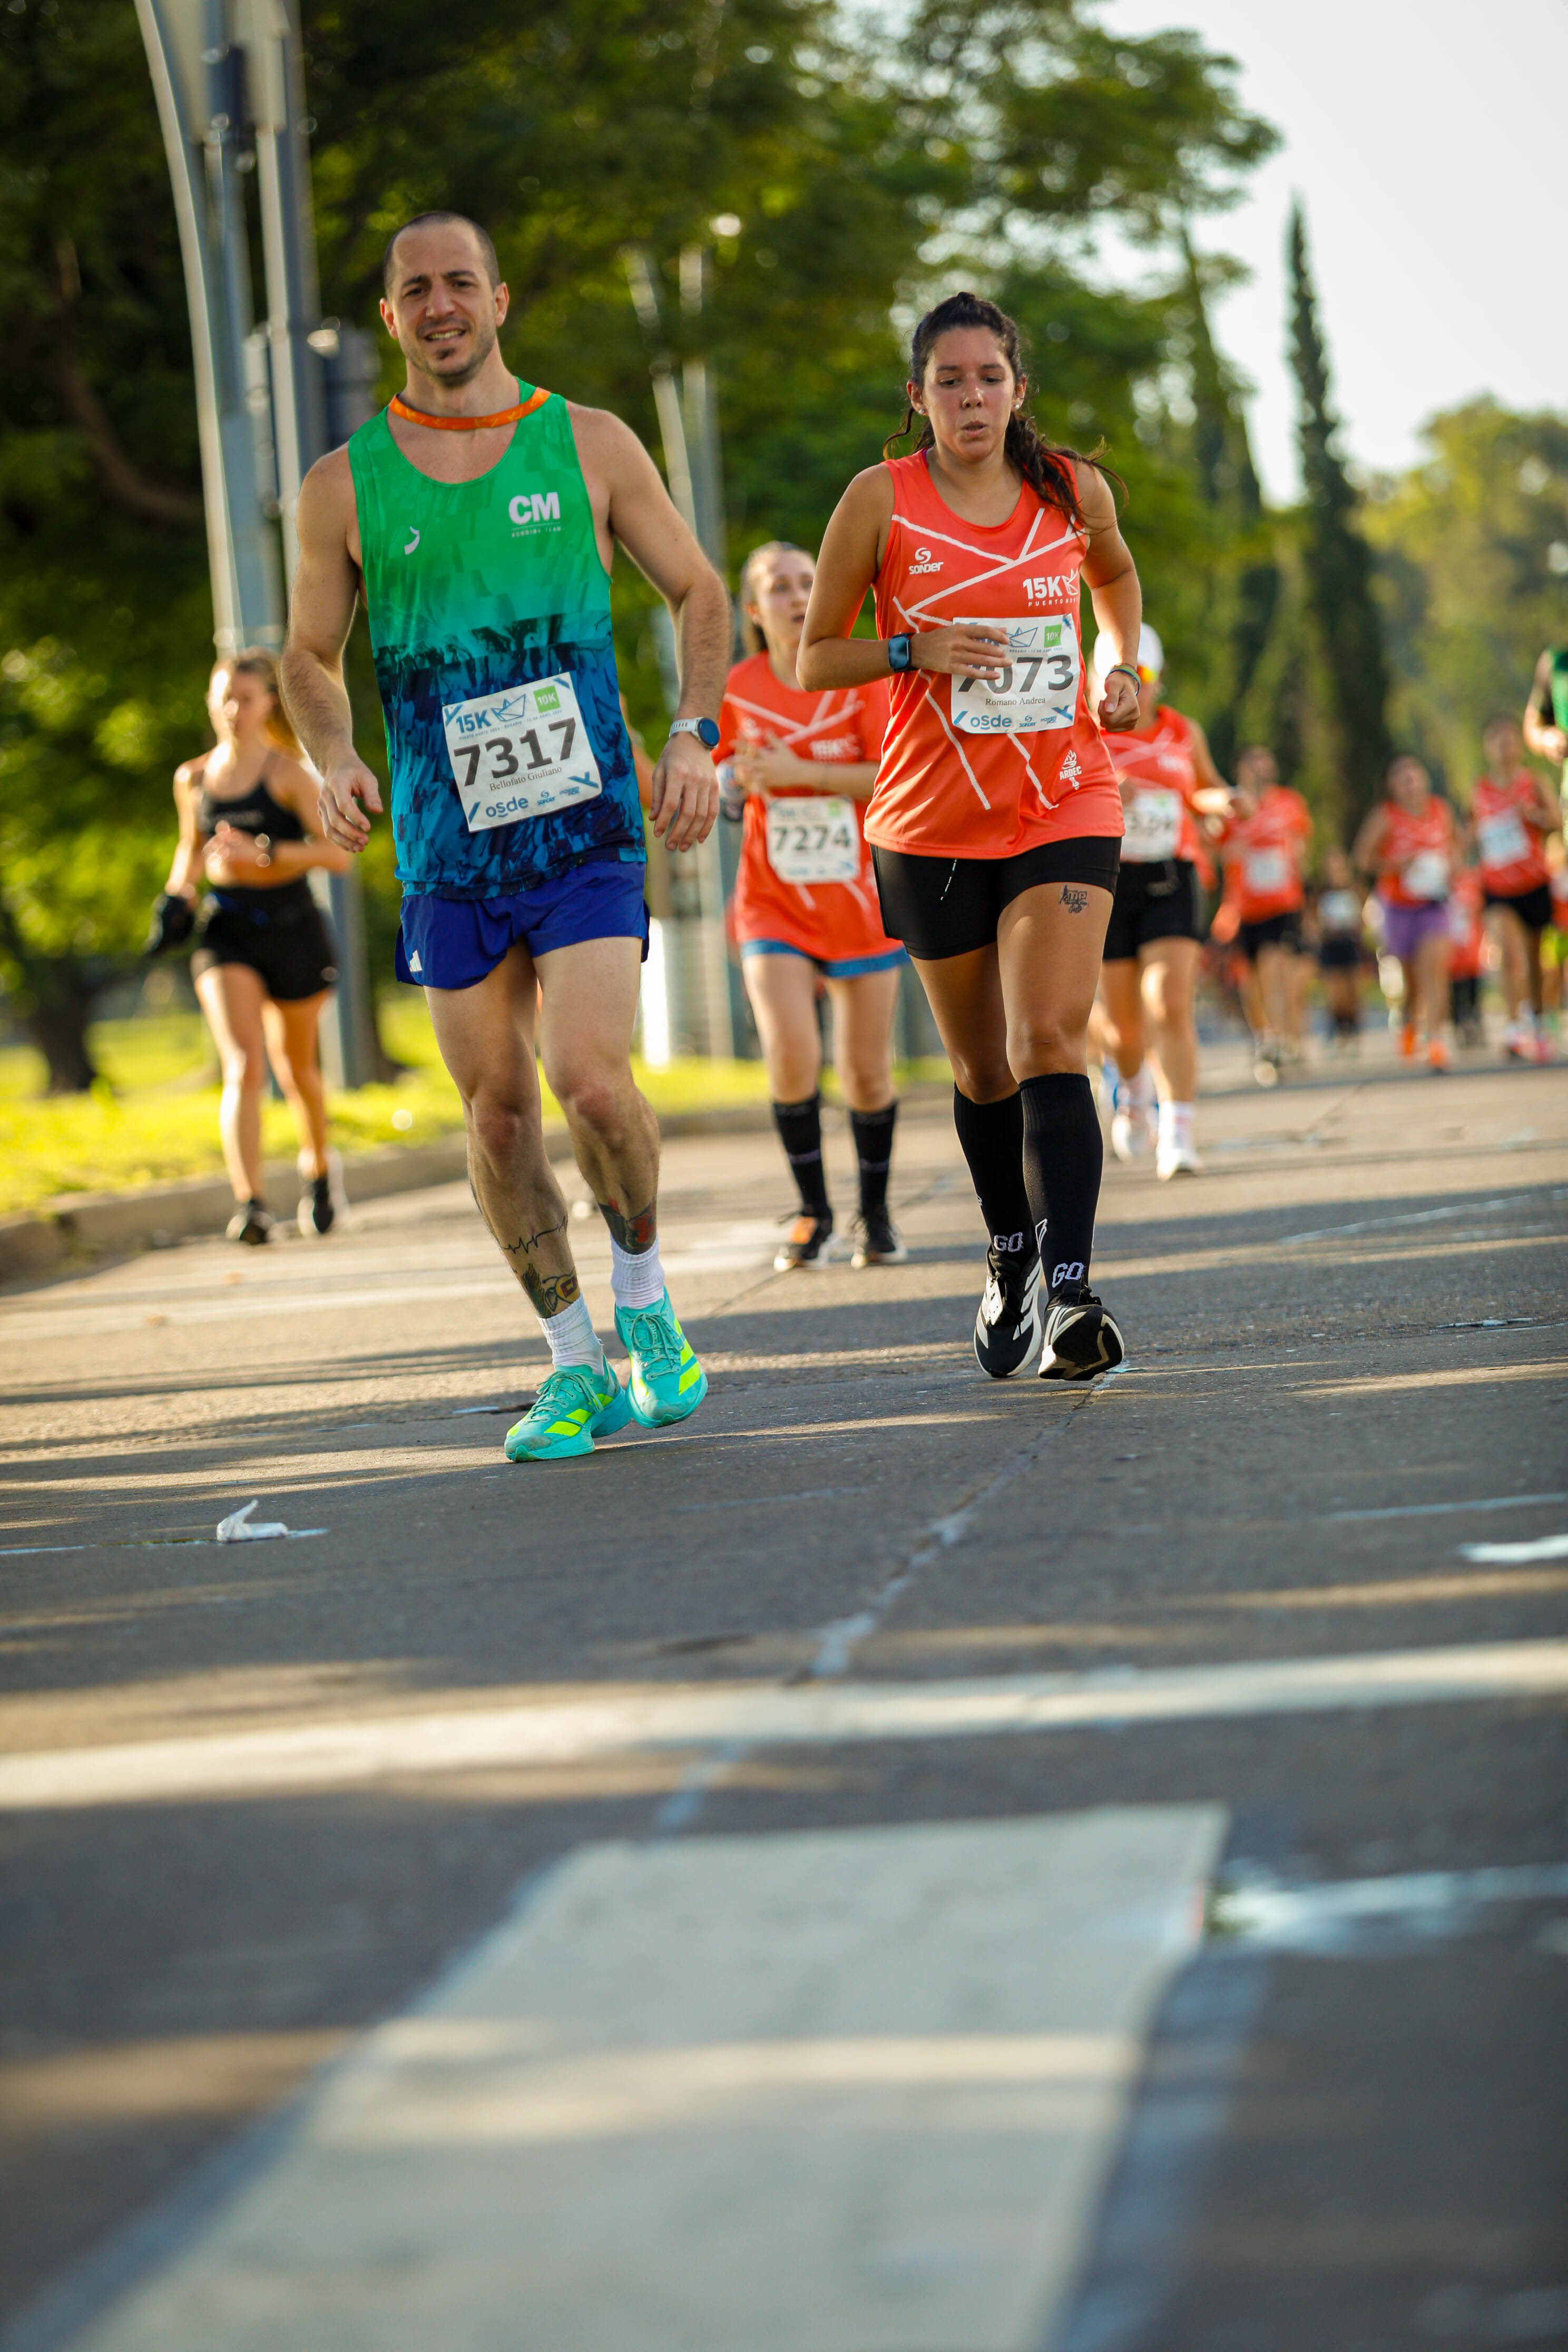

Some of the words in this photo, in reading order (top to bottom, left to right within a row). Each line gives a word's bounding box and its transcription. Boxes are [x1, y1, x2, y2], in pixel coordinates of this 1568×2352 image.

[508, 492, 561, 524] CM
[1023, 576, 1063, 599] 15K
[1028, 599, 1063, 607] PUERTO
[537, 693, 557, 705] 10K
[456, 709, 492, 733] 15K
[970, 714, 1012, 729] osde
[454, 717, 576, 787] 7317
[489, 776, 526, 791] Bellofato
[527, 767, 562, 781] Giuliano
[1059, 766, 1082, 780] ARDEC
[485, 796, 528, 817] osde
[773, 824, 851, 851] 7274
[994, 1232, 1023, 1252] GO
[1052, 1262, 1084, 1288] GO
